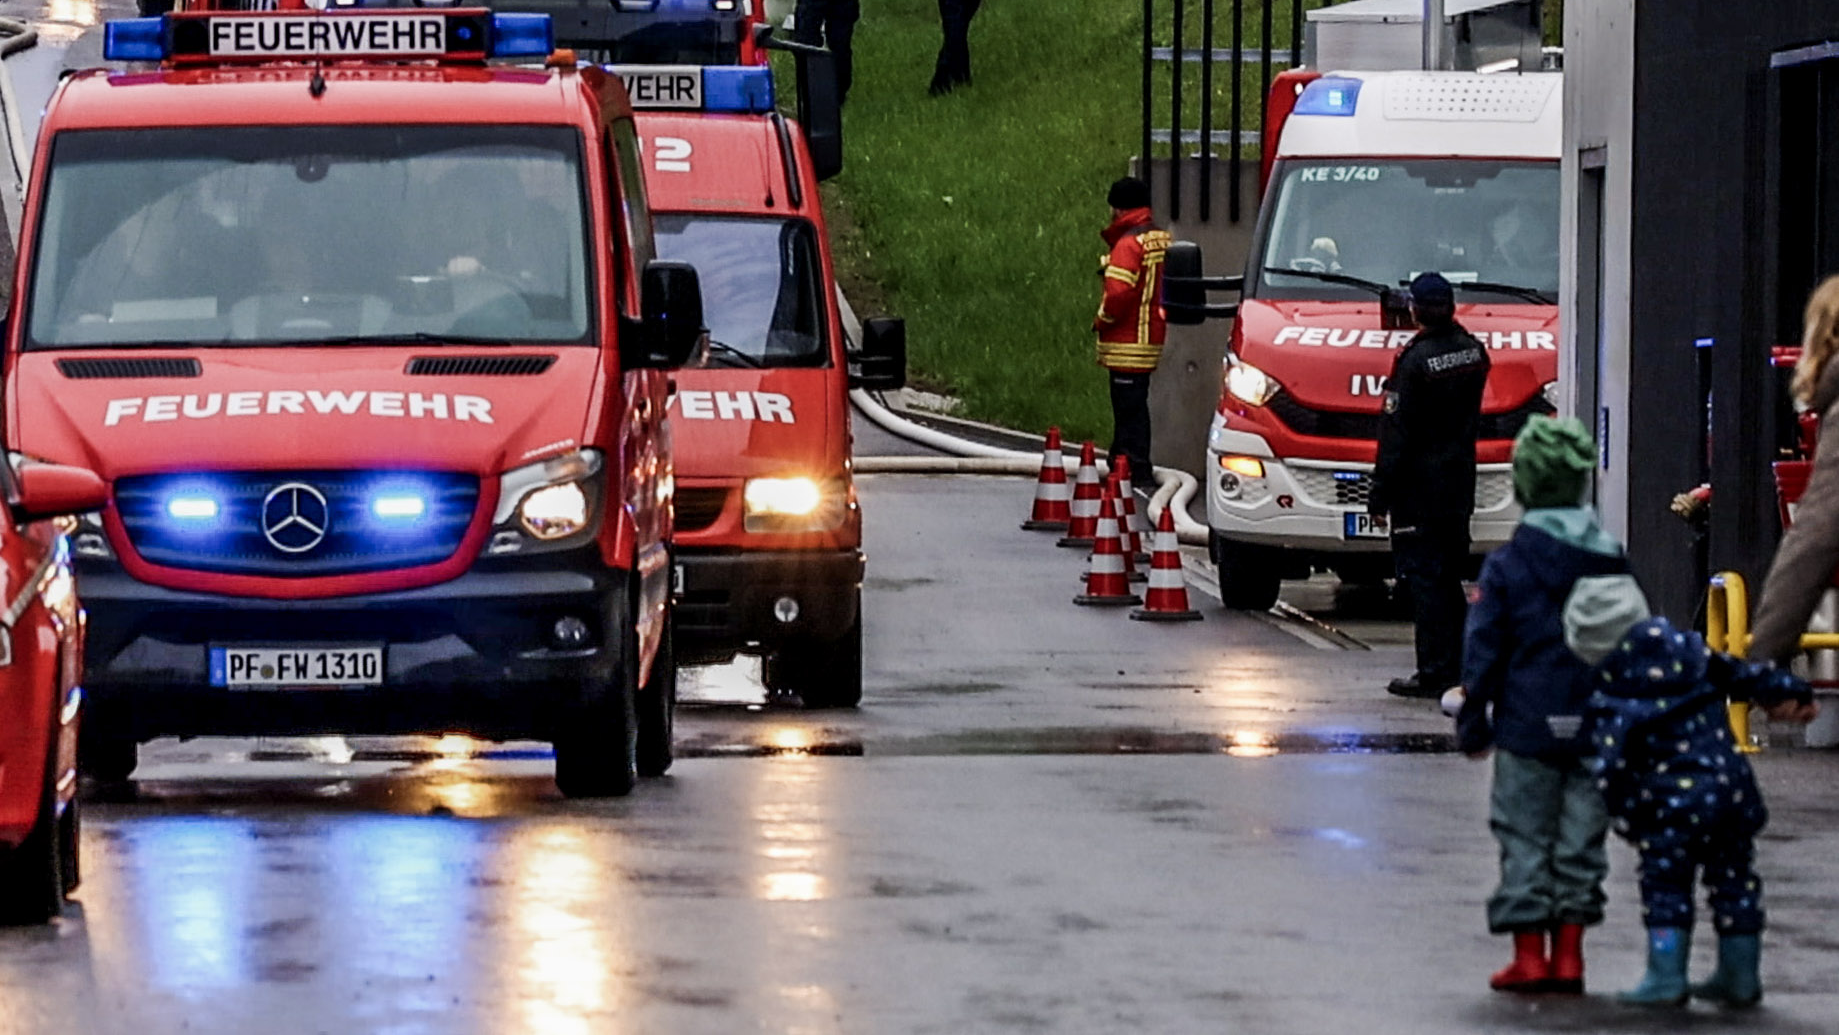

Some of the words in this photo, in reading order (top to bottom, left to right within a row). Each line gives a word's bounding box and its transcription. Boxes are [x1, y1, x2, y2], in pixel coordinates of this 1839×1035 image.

[212, 20, 442, 52] FEUERWEHR
[627, 76, 695, 101] EHR
[1301, 167, 1328, 181] KE
[1333, 167, 1380, 182] 3/40
[104, 390, 494, 427] FEUERWEHR
[230, 654, 260, 680] PF
[277, 653, 309, 680] FW
[315, 653, 377, 679] 1310
